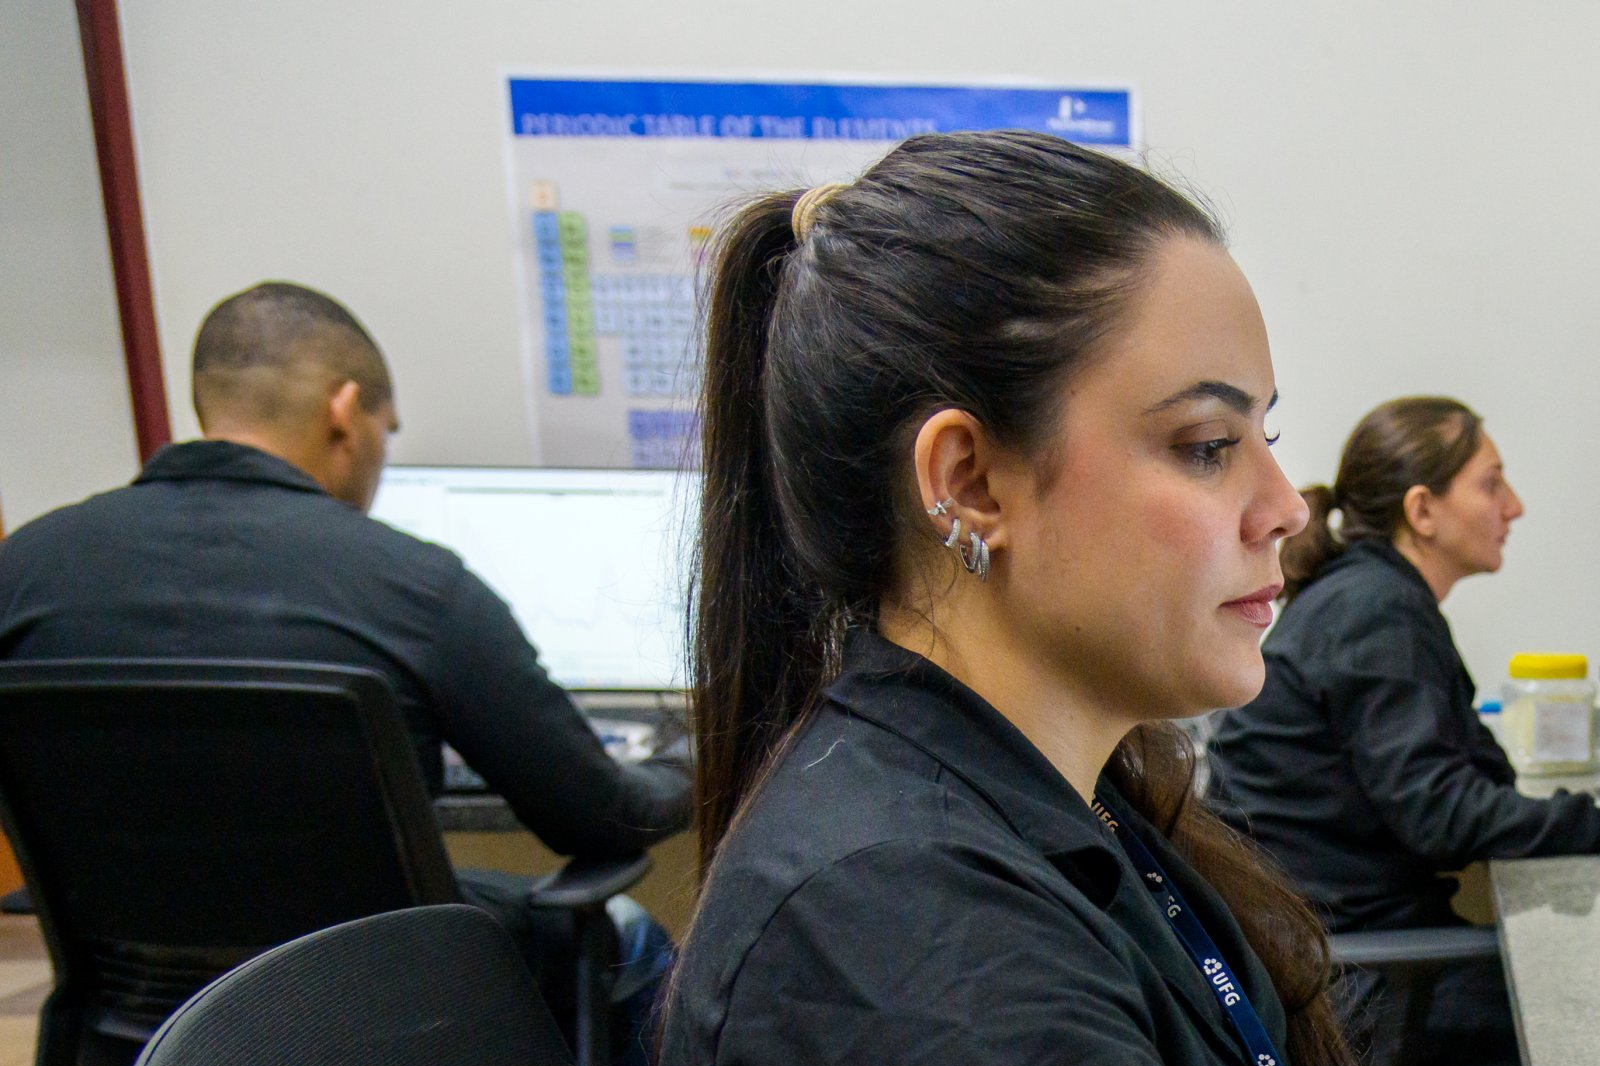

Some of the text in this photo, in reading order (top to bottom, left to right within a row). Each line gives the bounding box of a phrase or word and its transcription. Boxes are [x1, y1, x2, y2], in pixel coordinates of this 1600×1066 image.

[522, 113, 636, 136] PERIODIC
[643, 114, 715, 137] TABLE
[720, 116, 754, 138] OF
[758, 116, 806, 138] THE
[1212, 972, 1240, 1006] UFG
